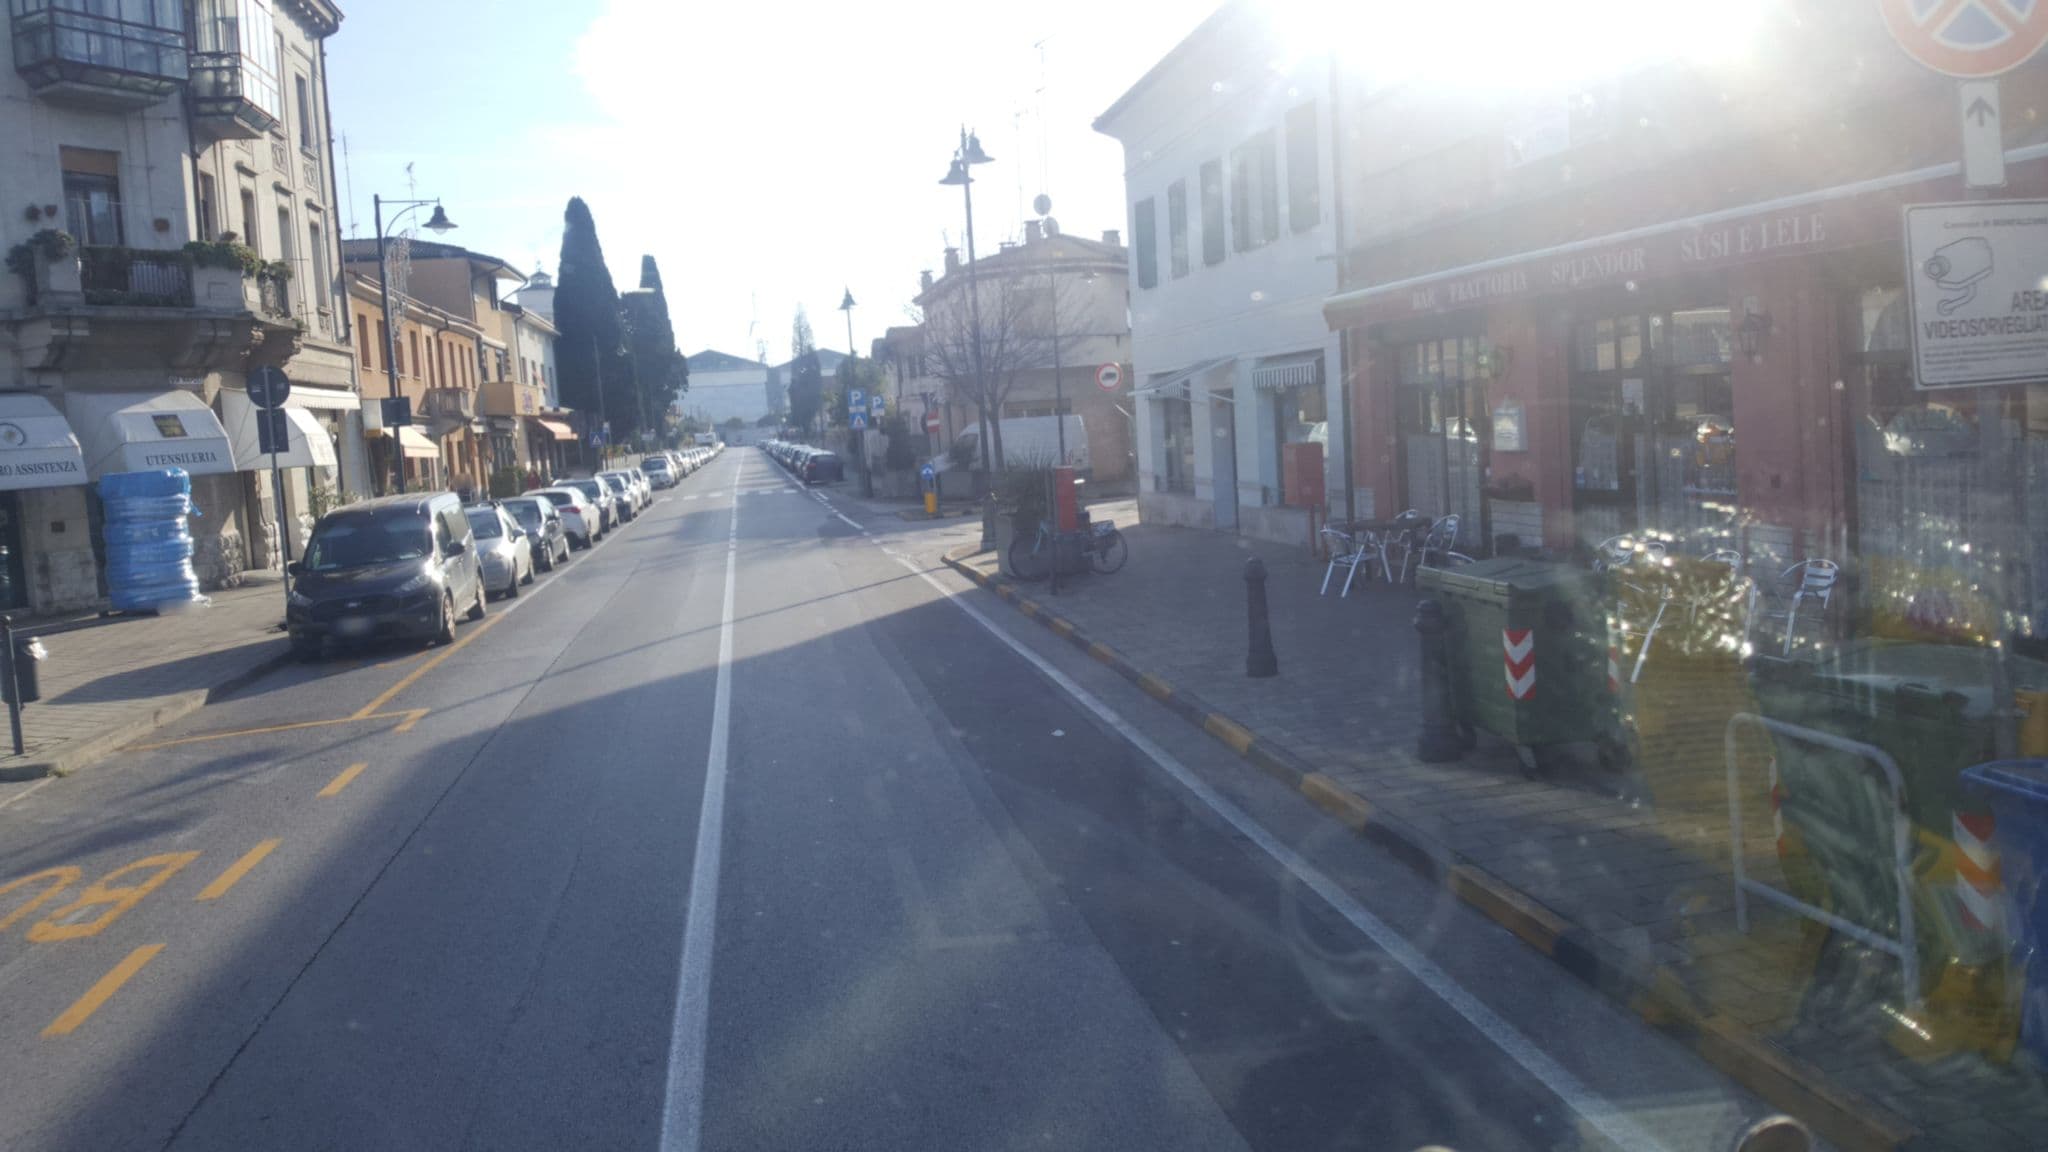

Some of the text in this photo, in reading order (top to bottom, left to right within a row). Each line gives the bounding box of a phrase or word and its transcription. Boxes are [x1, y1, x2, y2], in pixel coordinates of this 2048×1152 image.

[1551, 248, 1645, 284] SPLENDOR
[1680, 228, 1730, 262] SUSI
[850, 390, 862, 405] P
[145, 452, 217, 466] UTENSILERIA
[15, 461, 78, 476] ASSISTENZA
